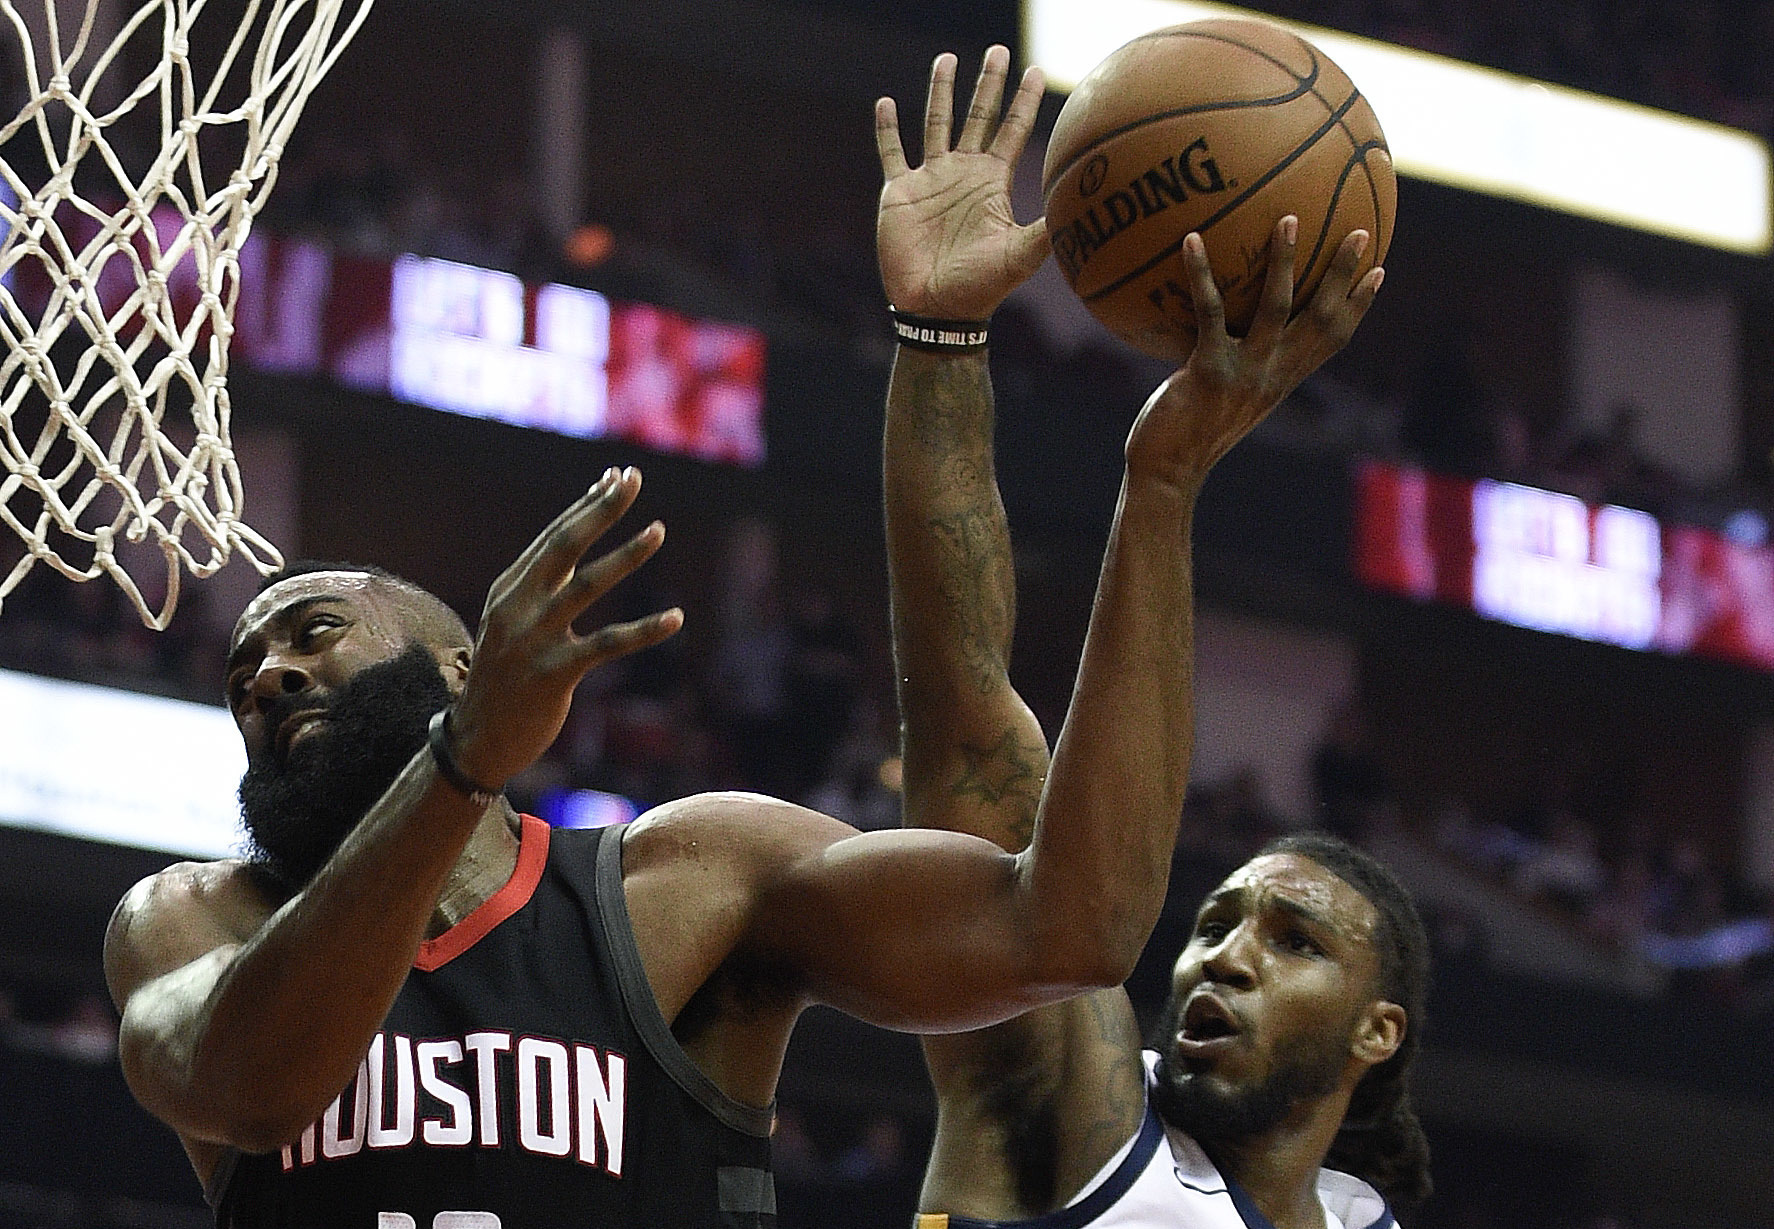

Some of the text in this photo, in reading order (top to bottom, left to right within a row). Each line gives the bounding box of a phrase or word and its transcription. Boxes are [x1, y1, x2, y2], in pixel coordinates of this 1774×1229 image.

[920, 327, 936, 343] TO
[938, 329, 966, 345] TIME
[279, 1029, 628, 1178] OUSTON
